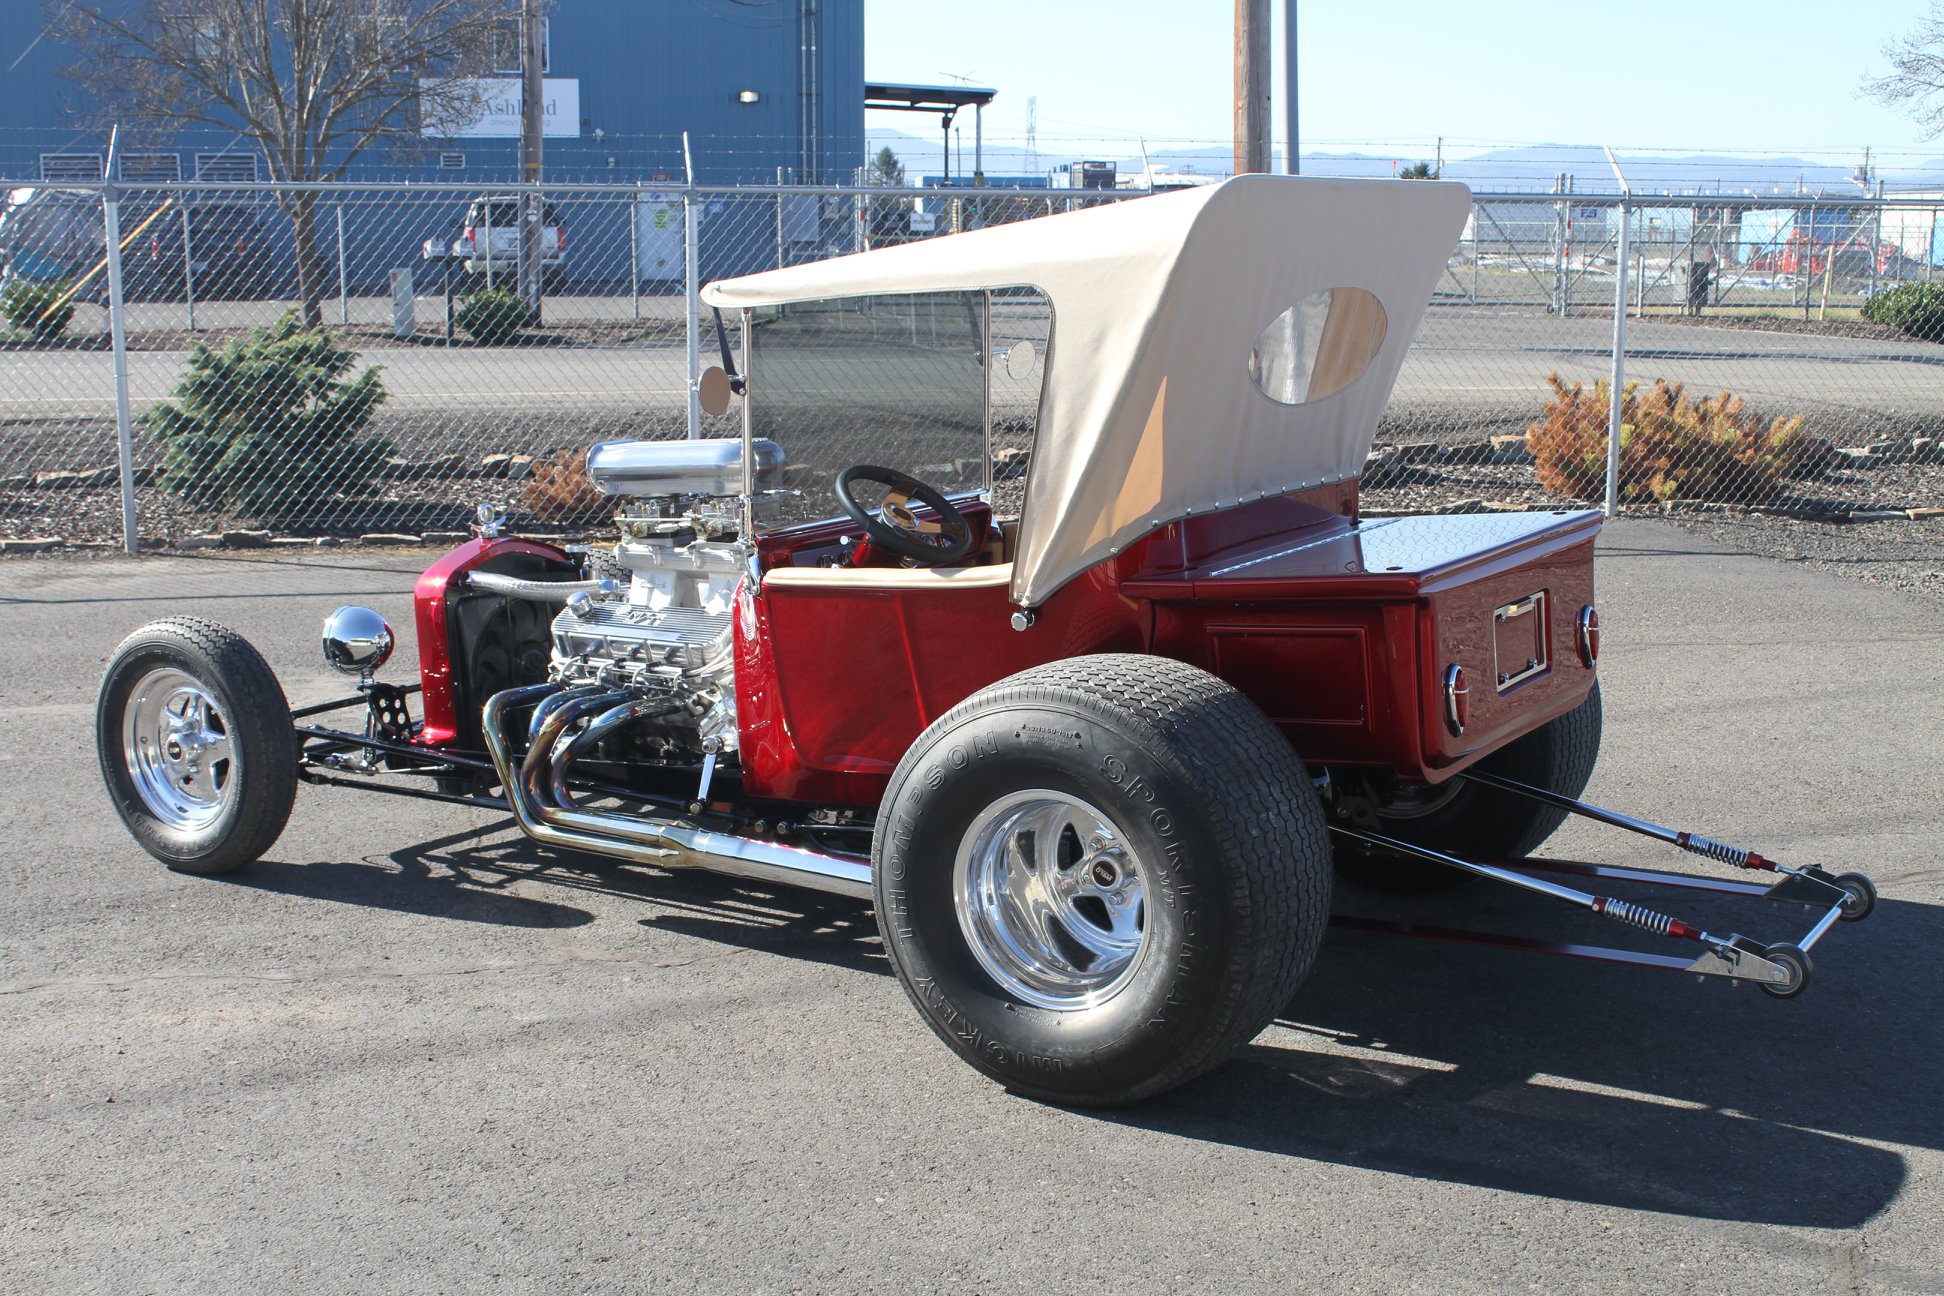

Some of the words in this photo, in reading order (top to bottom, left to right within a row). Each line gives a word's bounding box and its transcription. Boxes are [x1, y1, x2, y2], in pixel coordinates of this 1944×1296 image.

[483, 98, 557, 116] Ashld
[890, 729, 1000, 945] THOMPSON
[1101, 754, 1202, 1030] SPORTSMAN
[1158, 870, 1176, 908] M/T
[915, 976, 1063, 1078] MICKEY
